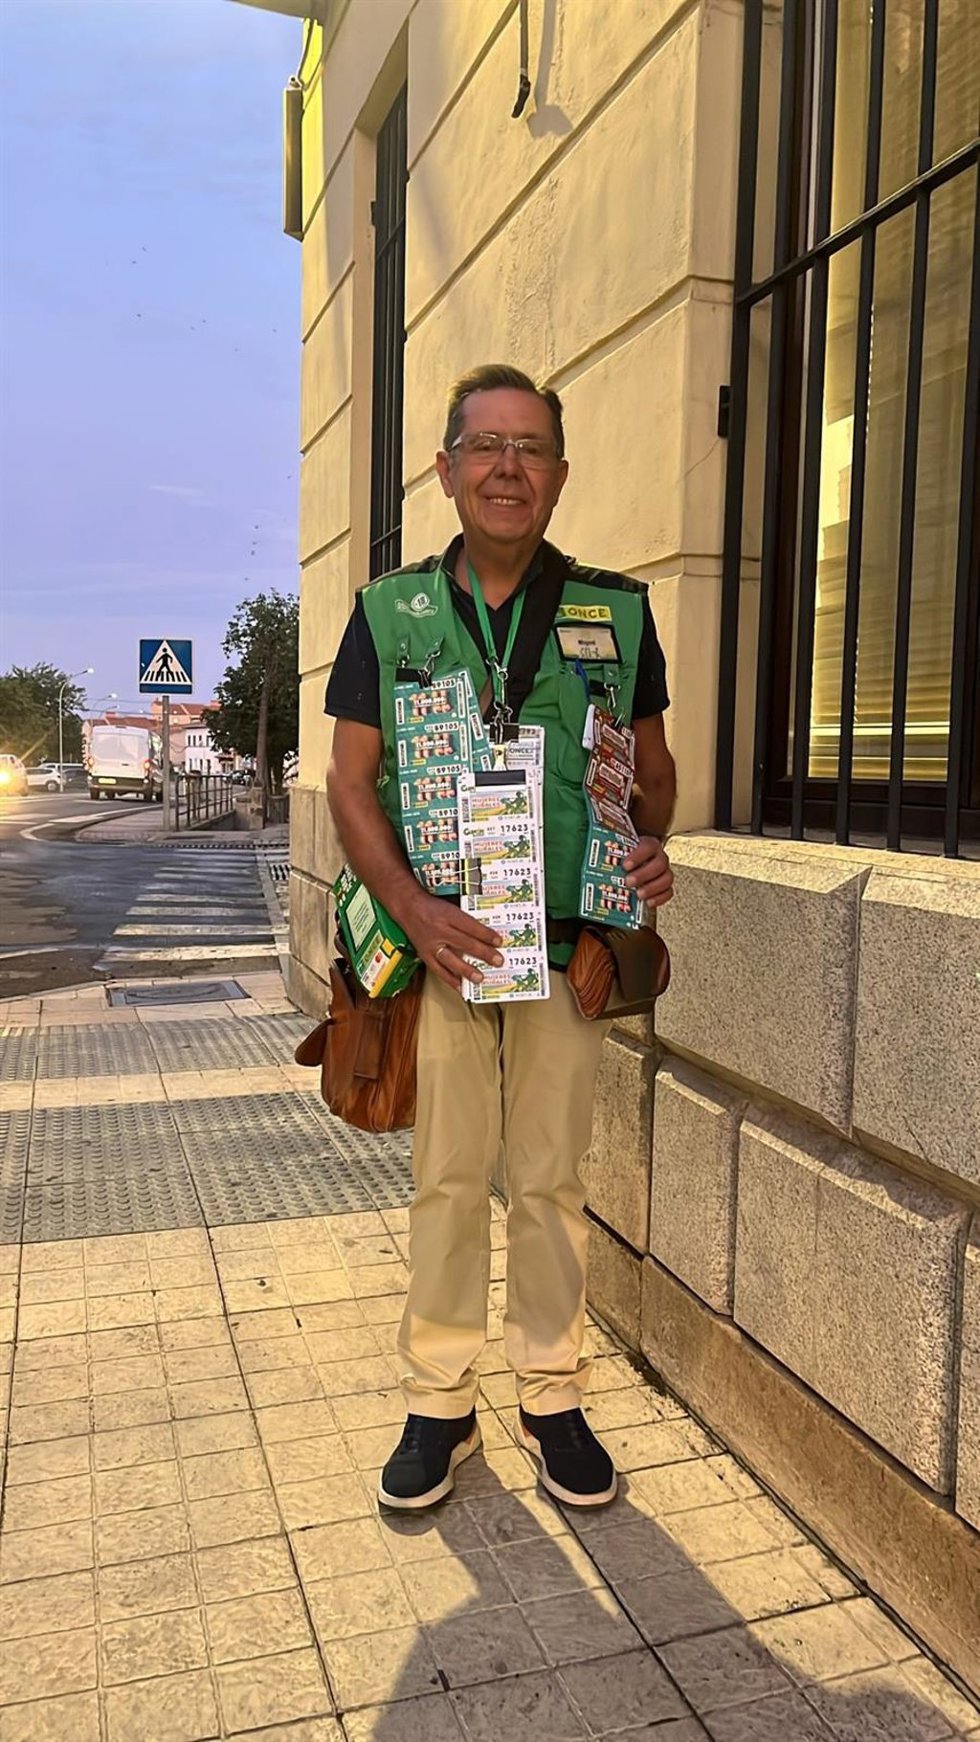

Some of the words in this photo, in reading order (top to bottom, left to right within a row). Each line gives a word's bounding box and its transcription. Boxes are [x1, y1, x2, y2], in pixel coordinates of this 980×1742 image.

[567, 607, 607, 618] ONCE
[500, 823, 528, 833] 17623
[503, 867, 531, 877] 17623
[506, 912, 534, 921] 17623
[509, 956, 537, 966] 17623
